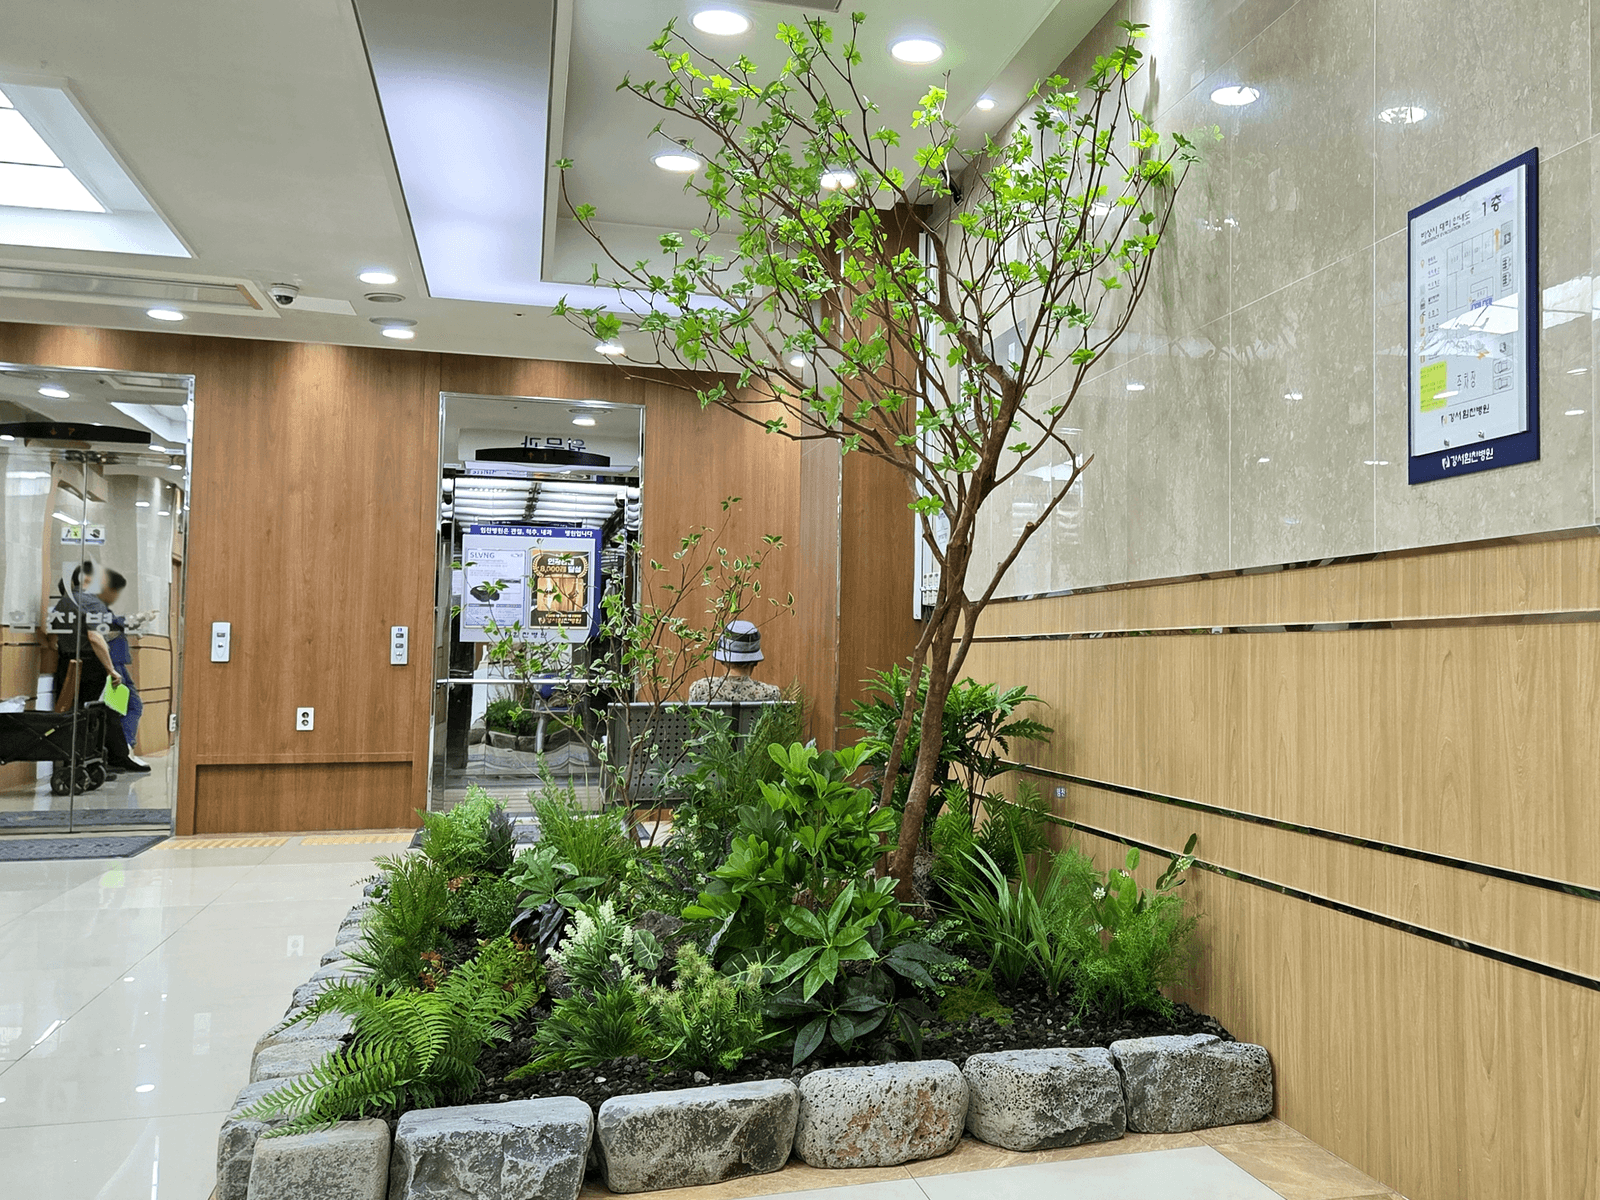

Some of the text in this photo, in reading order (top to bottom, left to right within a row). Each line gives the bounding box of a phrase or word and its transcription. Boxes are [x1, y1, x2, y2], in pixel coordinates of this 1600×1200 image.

[1420, 210, 1471, 239] 비상시 대피 안내도
[1448, 403, 1490, 423] 강서힘찬병원
[1449, 447, 1494, 467] 강서힘찬병원
